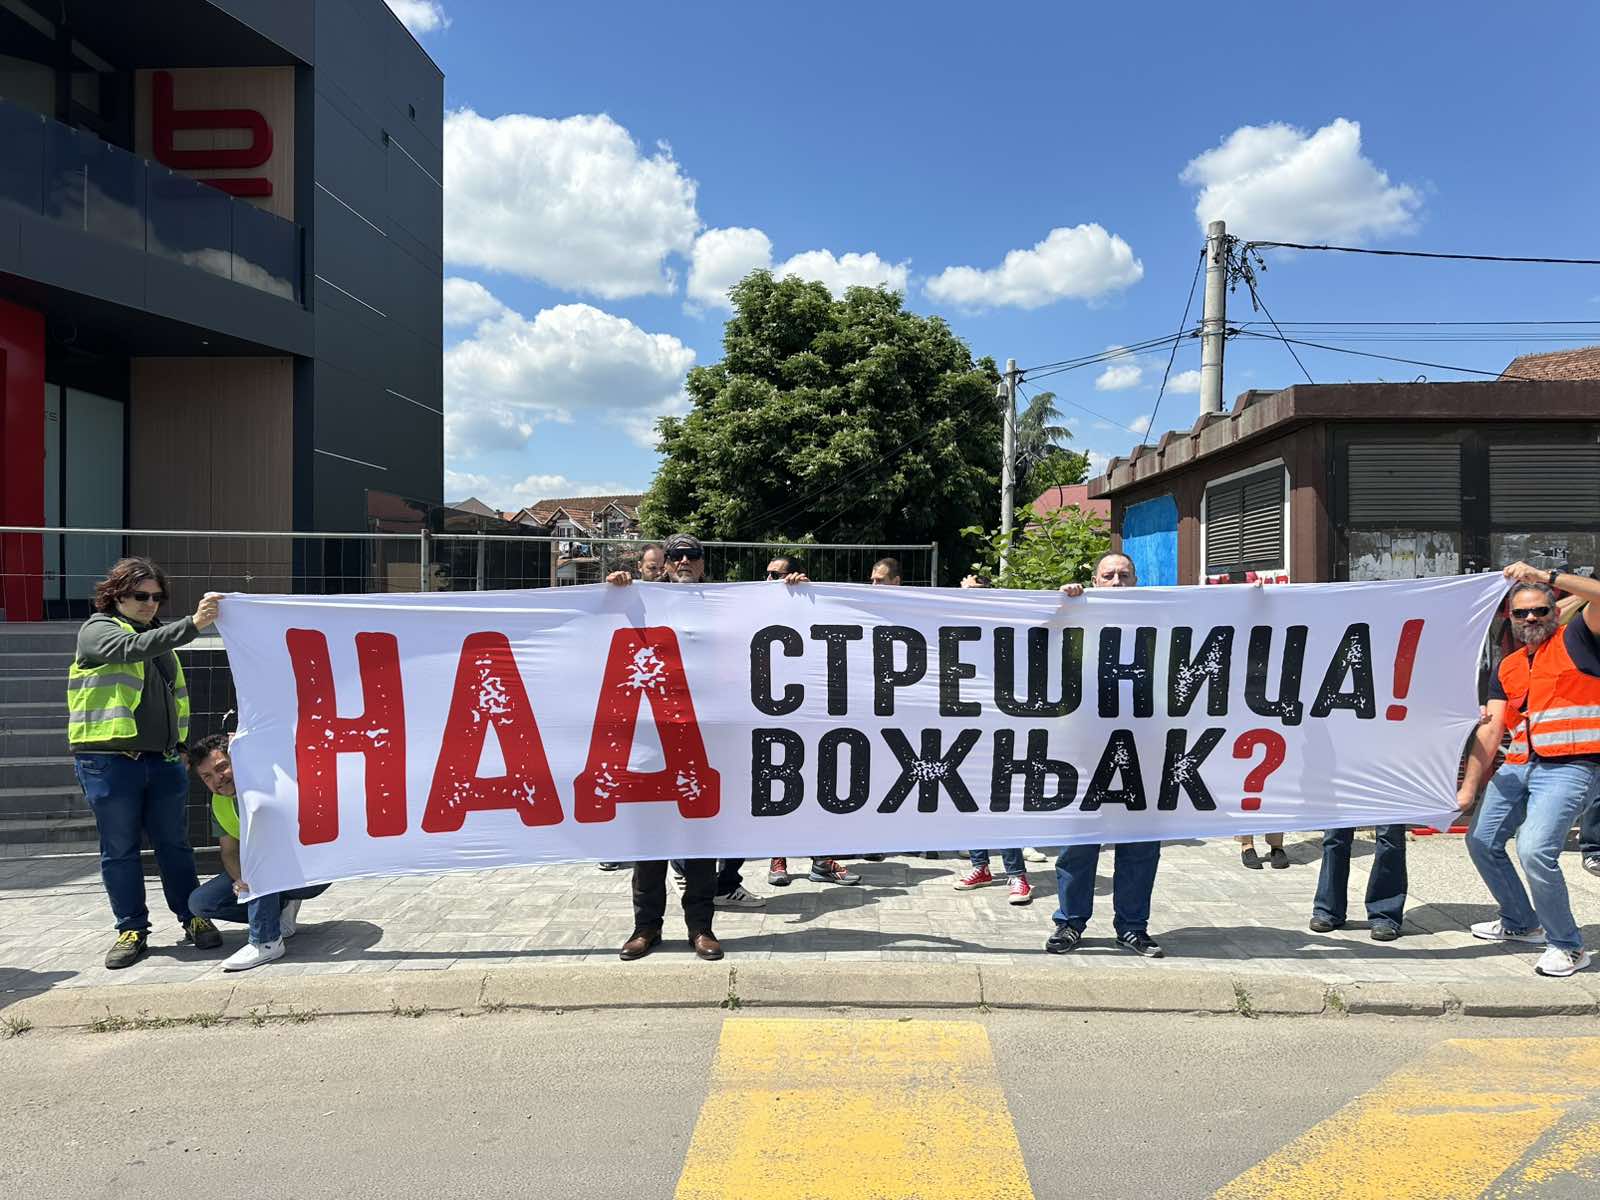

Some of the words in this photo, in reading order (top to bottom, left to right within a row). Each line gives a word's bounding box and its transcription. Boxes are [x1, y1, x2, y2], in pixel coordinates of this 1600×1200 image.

[750, 619, 1425, 726] СТРЕШНИЦА!
[286, 626, 721, 846] НАД
[751, 727, 1286, 817] ВОЖЊАК?
